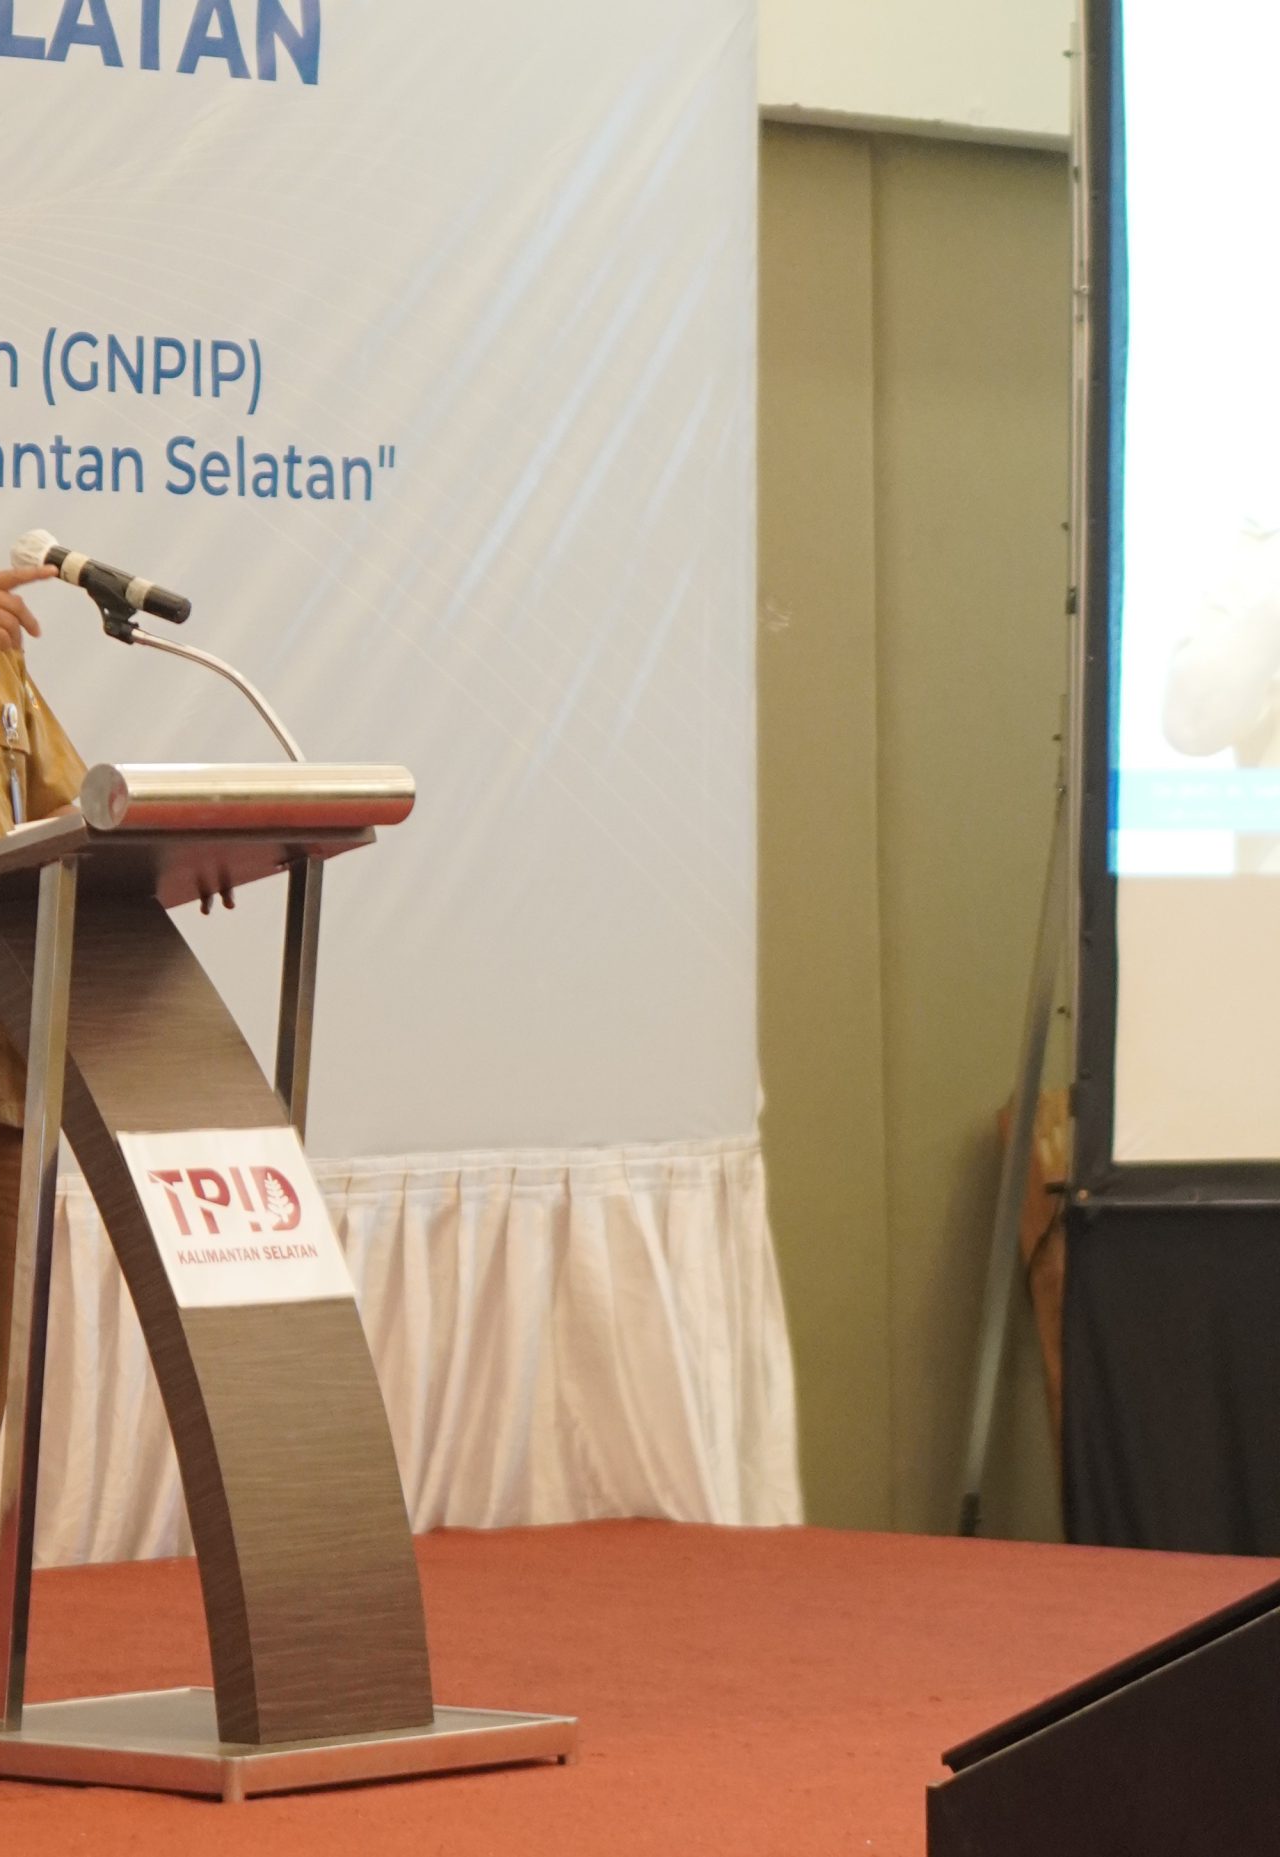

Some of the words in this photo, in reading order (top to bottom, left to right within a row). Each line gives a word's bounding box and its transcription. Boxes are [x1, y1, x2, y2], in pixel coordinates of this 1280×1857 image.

[42, 327, 263, 417] (GNPIP)
[165, 435, 397, 504] Selatan"
[177, 1247, 261, 1265] KALIMANTAN
[263, 1243, 319, 1261] SELATAN
